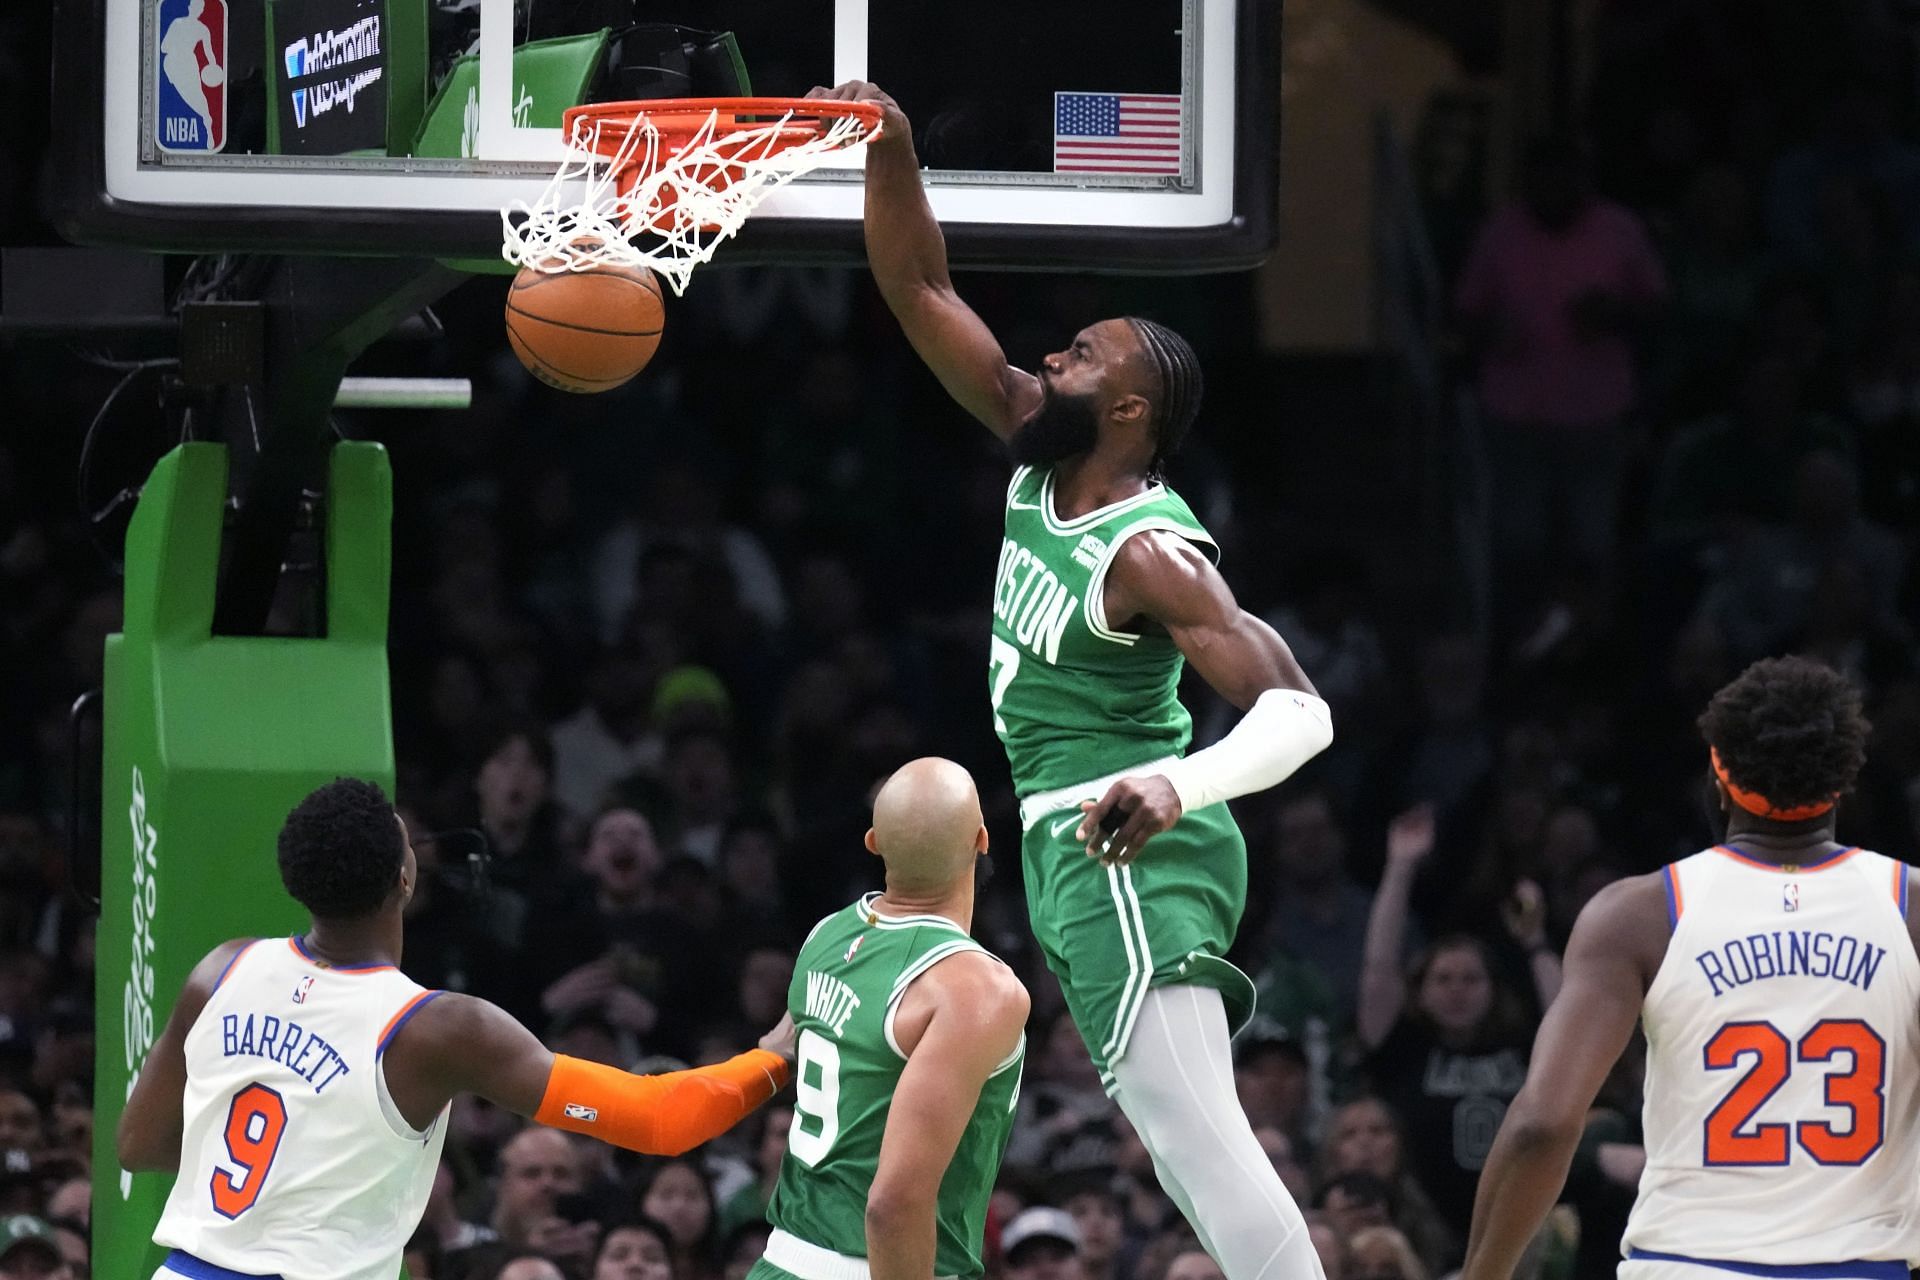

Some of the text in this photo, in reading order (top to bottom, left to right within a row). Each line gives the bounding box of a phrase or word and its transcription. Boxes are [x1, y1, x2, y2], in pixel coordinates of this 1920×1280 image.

[166, 117, 199, 142] NBA
[993, 536, 1079, 665] OSTON
[989, 634, 1020, 733] 7
[805, 970, 861, 1038] WHITE
[1695, 931, 1887, 997] ROBINSON
[223, 1013, 350, 1094] BARRETT
[788, 1028, 841, 1168] 9
[1703, 1018, 1887, 1167] 23
[210, 1081, 288, 1221] 9
